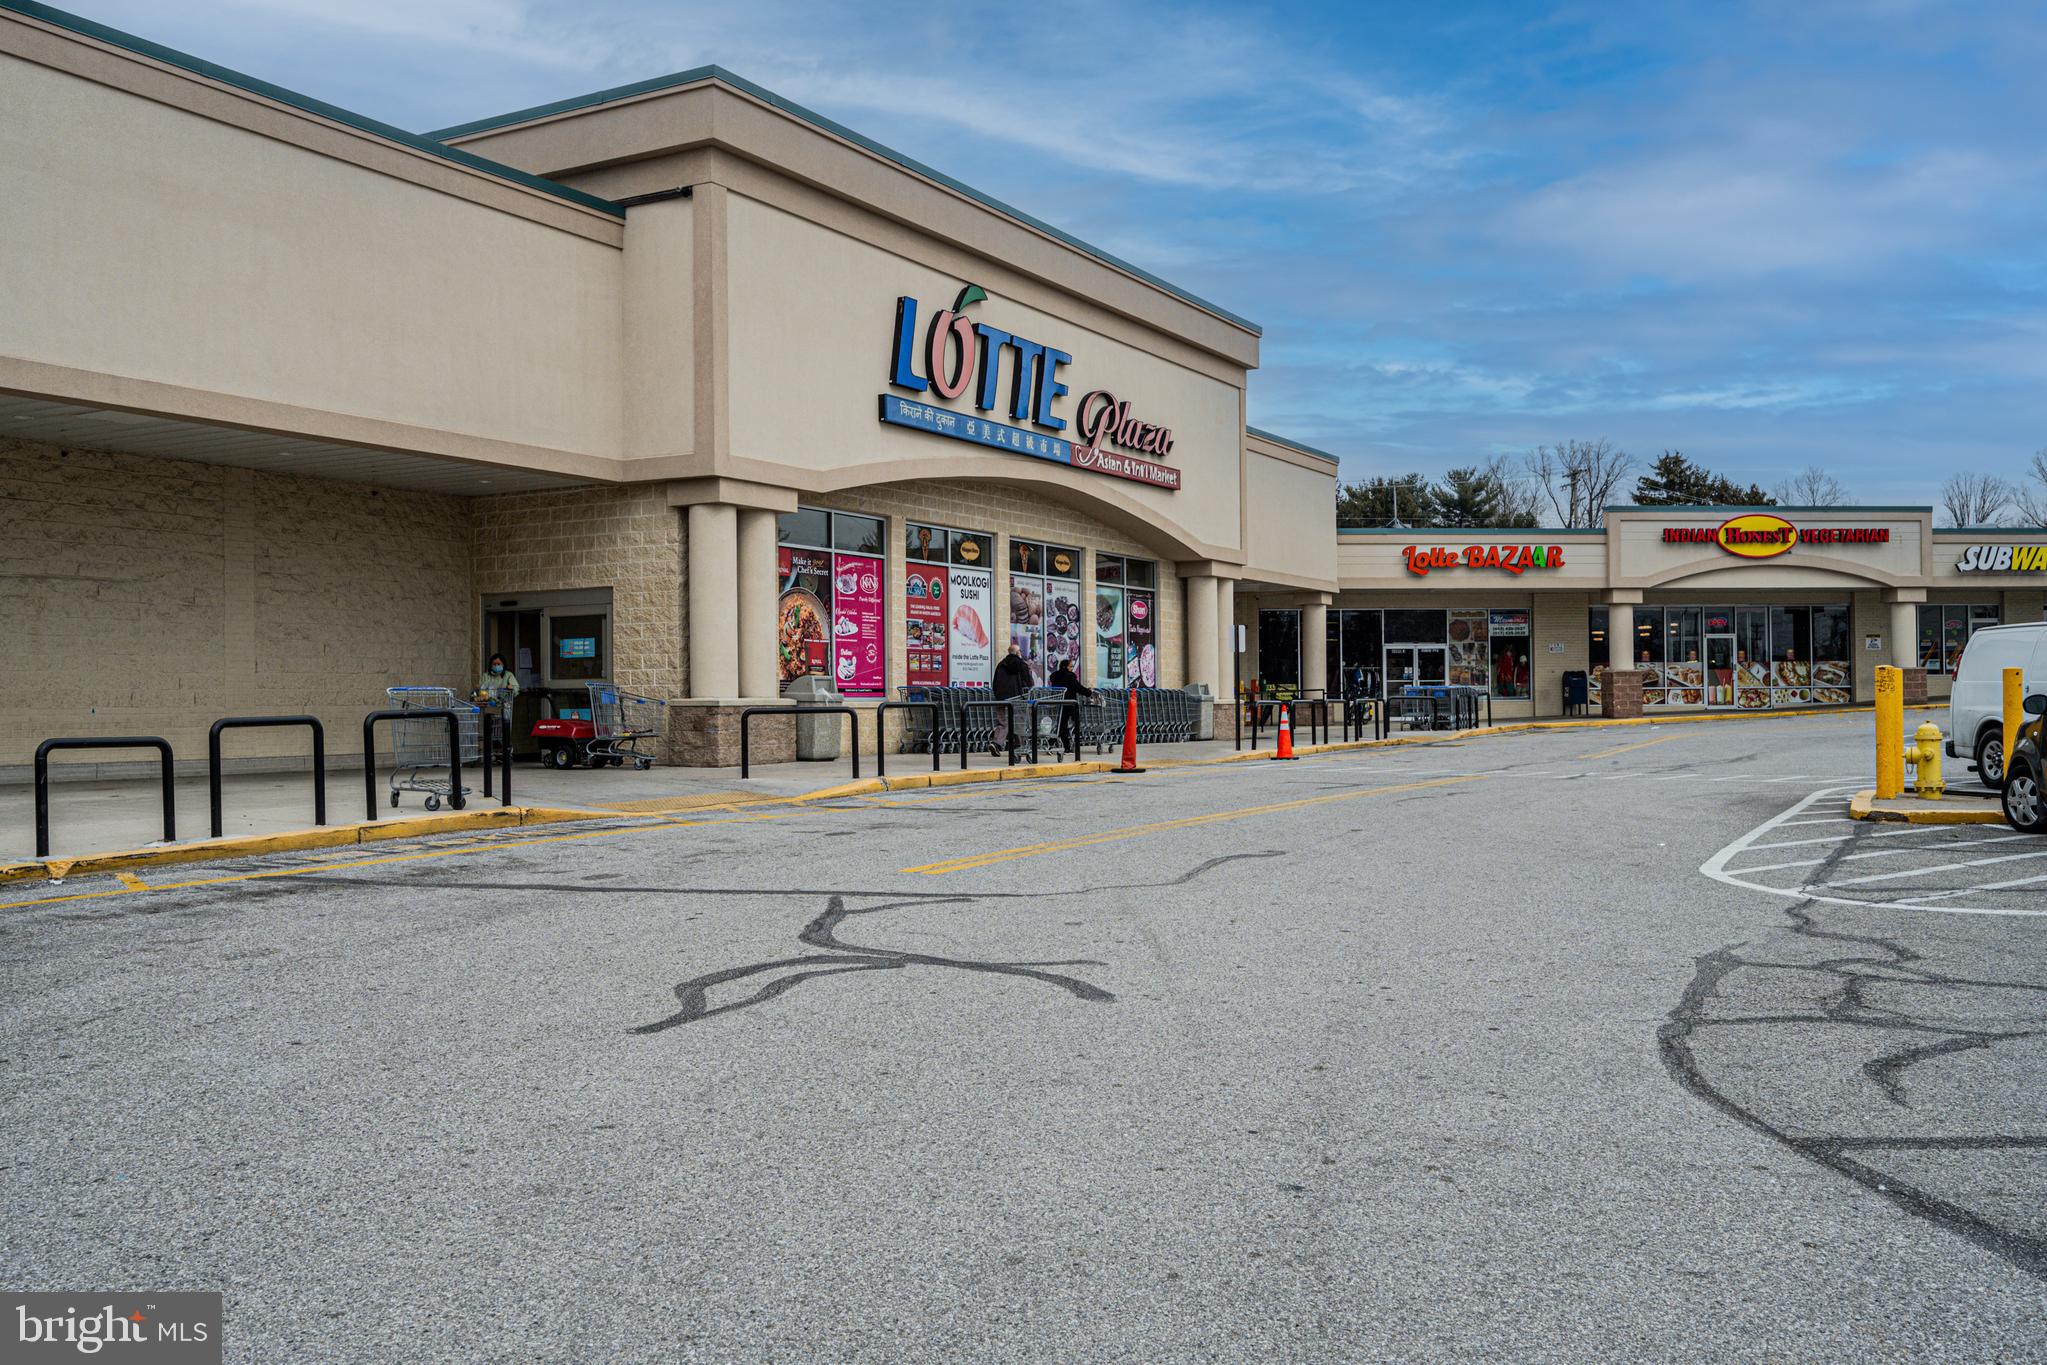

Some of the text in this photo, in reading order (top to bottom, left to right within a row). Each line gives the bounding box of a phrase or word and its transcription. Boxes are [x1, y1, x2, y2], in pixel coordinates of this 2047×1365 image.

[889, 293, 1072, 431] LOTTE
[899, 400, 956, 430] किराने की दुकान
[1076, 390, 1174, 462] Plaza
[1097, 452, 1122, 472] Asian
[1124, 460, 1131, 475] &
[1149, 464, 1177, 485] Market
[1662, 528, 1718, 543] INDIAN
[1799, 528, 1889, 543] VEGETARIAN
[792, 556, 807, 566] Make
[1402, 545, 1566, 576] Lotte BAZAAR
[797, 565, 829, 577] Chef's Secret
[951, 575, 989, 588] MOOLKOGI
[960, 589, 980, 600] SUSHI
